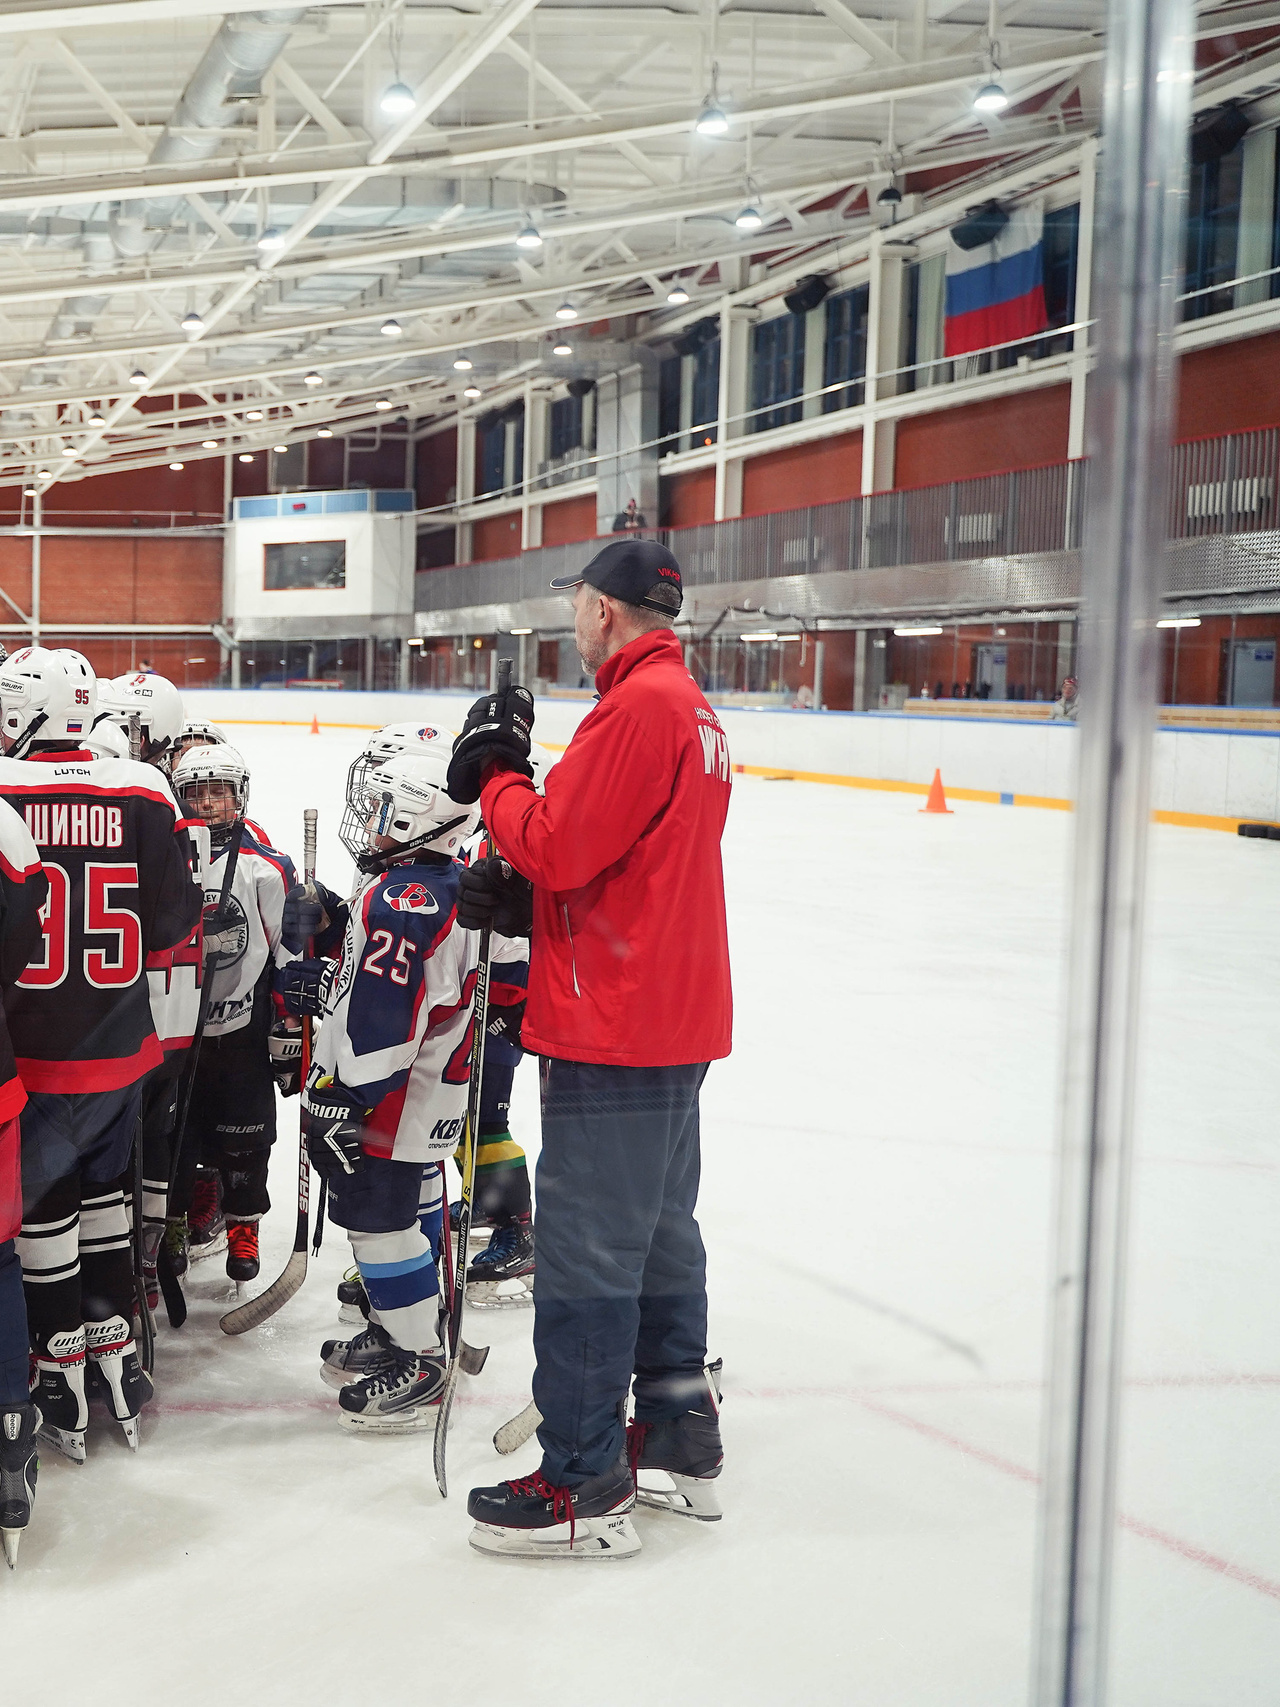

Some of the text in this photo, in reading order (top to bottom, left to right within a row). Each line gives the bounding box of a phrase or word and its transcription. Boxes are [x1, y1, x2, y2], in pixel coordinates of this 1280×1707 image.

[0, 681, 23, 691] BAUER
[74, 688, 90, 705] 95
[54, 768, 91, 777] LUTCH
[400, 782, 429, 799] BAUER
[362, 928, 418, 987] 25
[474, 962, 487, 1021] BAUER
[215, 1123, 265, 1135] BAUER
